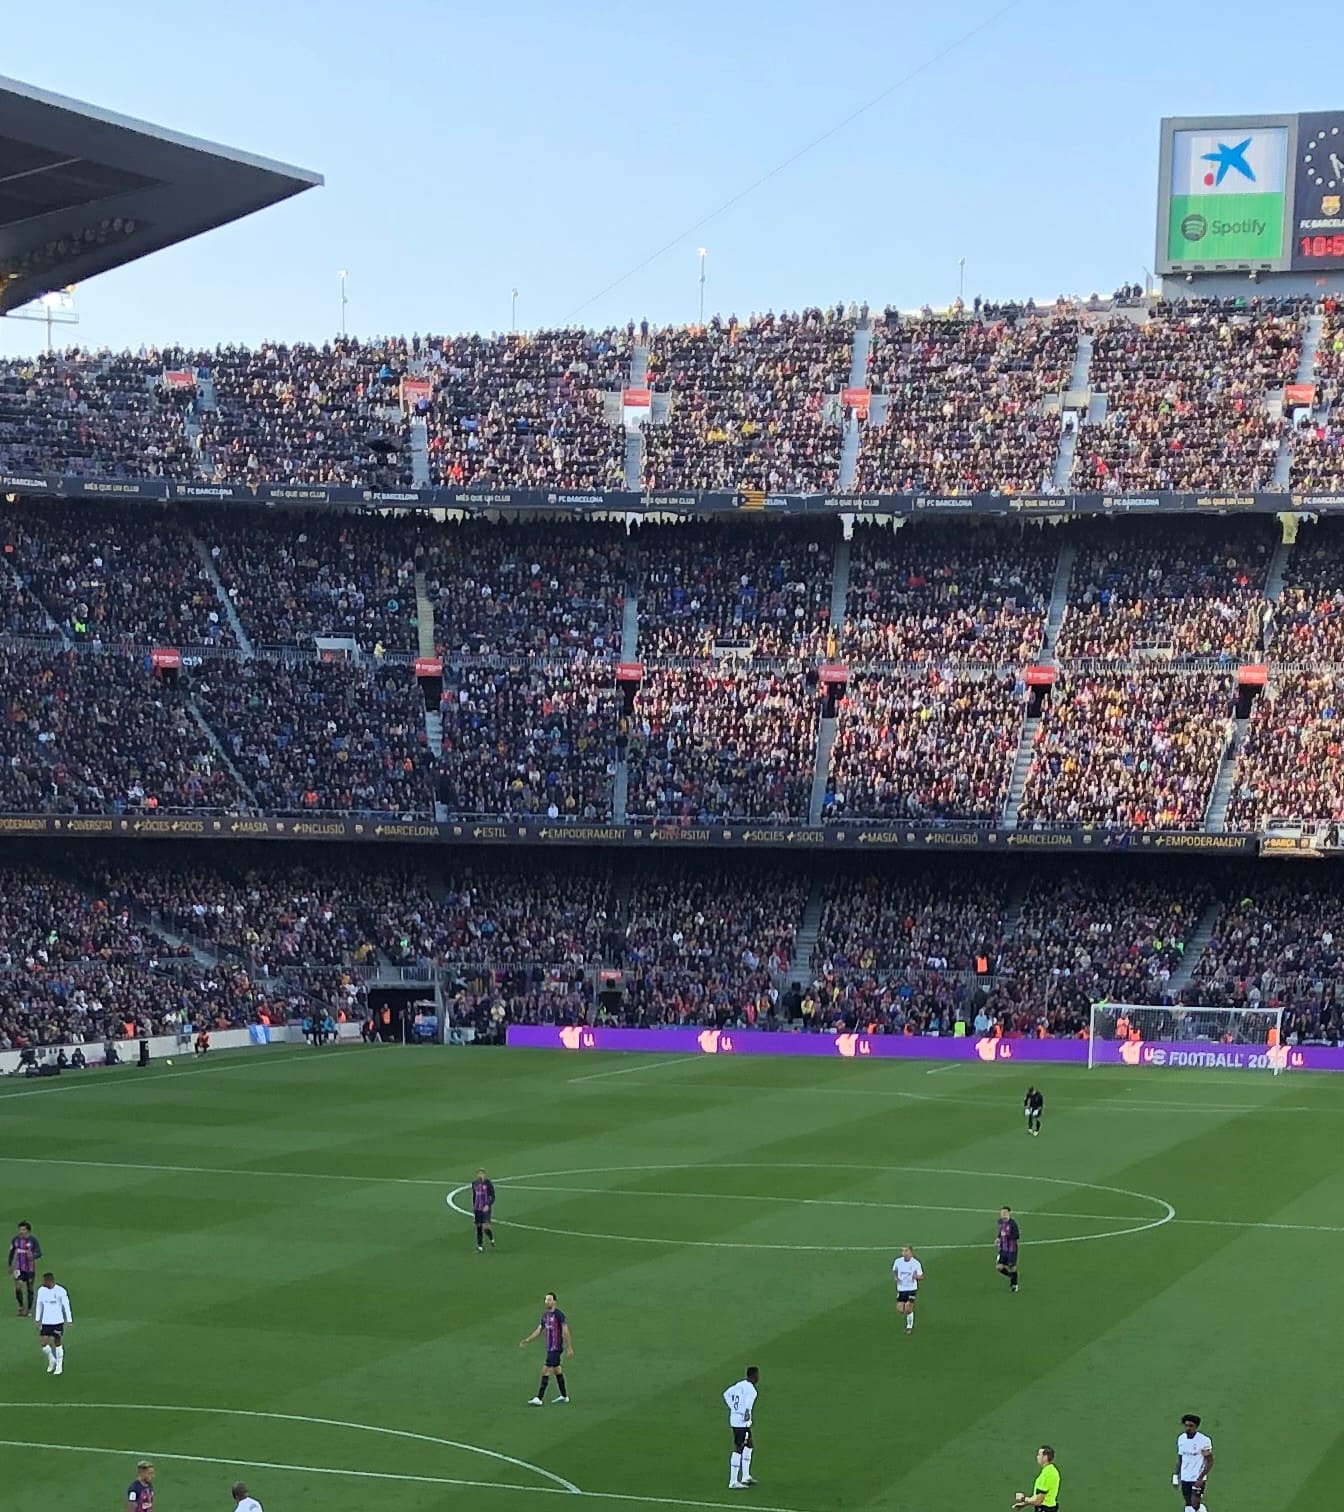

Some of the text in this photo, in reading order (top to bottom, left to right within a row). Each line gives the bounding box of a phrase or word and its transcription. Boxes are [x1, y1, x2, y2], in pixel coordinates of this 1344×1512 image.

[1211, 219, 1266, 236] Spotify
[1300, 220, 1311, 230] FC
[936, 499, 973, 507] BARCELONA
[1123, 498, 1159, 507] BARCELONA
[1168, 1050, 1242, 1068] FOOTBALL
